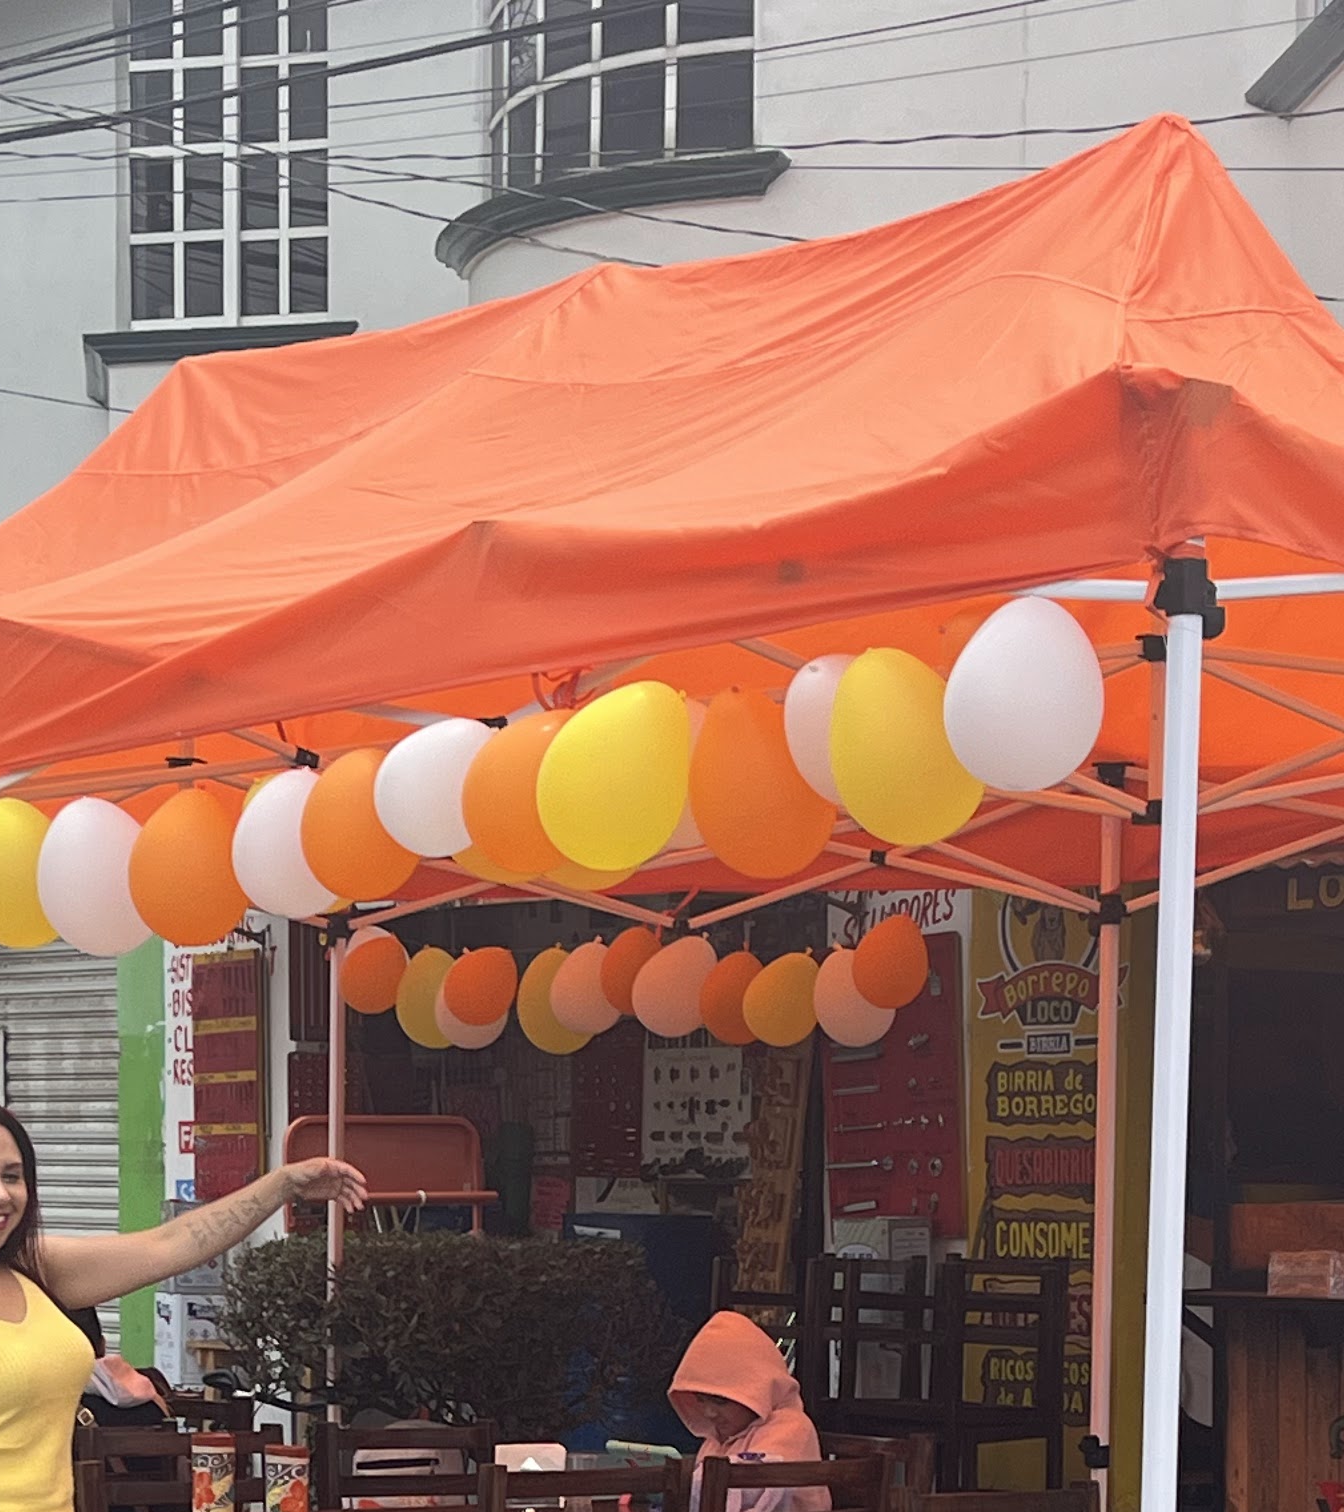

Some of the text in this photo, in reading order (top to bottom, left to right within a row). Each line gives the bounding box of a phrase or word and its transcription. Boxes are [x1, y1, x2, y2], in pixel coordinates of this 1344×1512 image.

[1027, 1000, 1072, 1024] LOCO
[997, 1068, 1083, 1093] BIRRIA de
[997, 1093, 1096, 1118] BORREGO
[996, 1220, 1091, 1260] CONSOME
[990, 1357, 1034, 1381] RICOS
